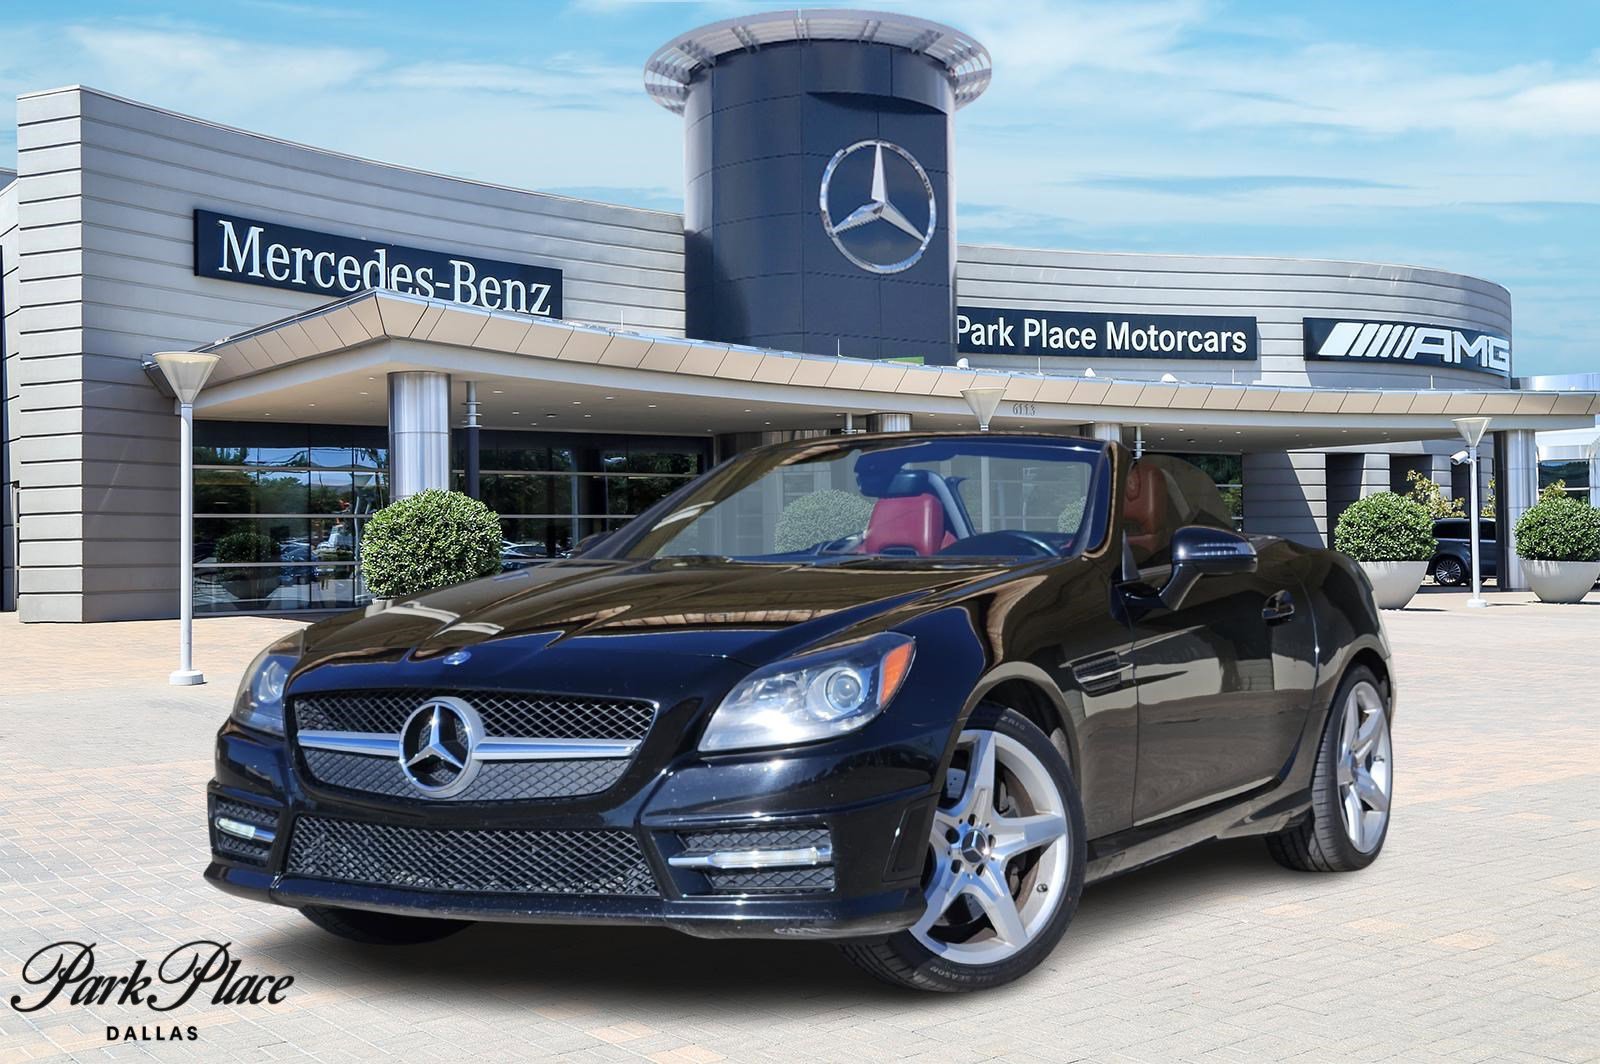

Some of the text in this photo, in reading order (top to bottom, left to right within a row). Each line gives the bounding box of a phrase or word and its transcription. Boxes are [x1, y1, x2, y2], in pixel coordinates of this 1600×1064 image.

[218, 219, 552, 316] Mercedes-Benz
[957, 315, 1248, 354] Park Place Motorcars
[1012, 402, 1036, 416] 6113
